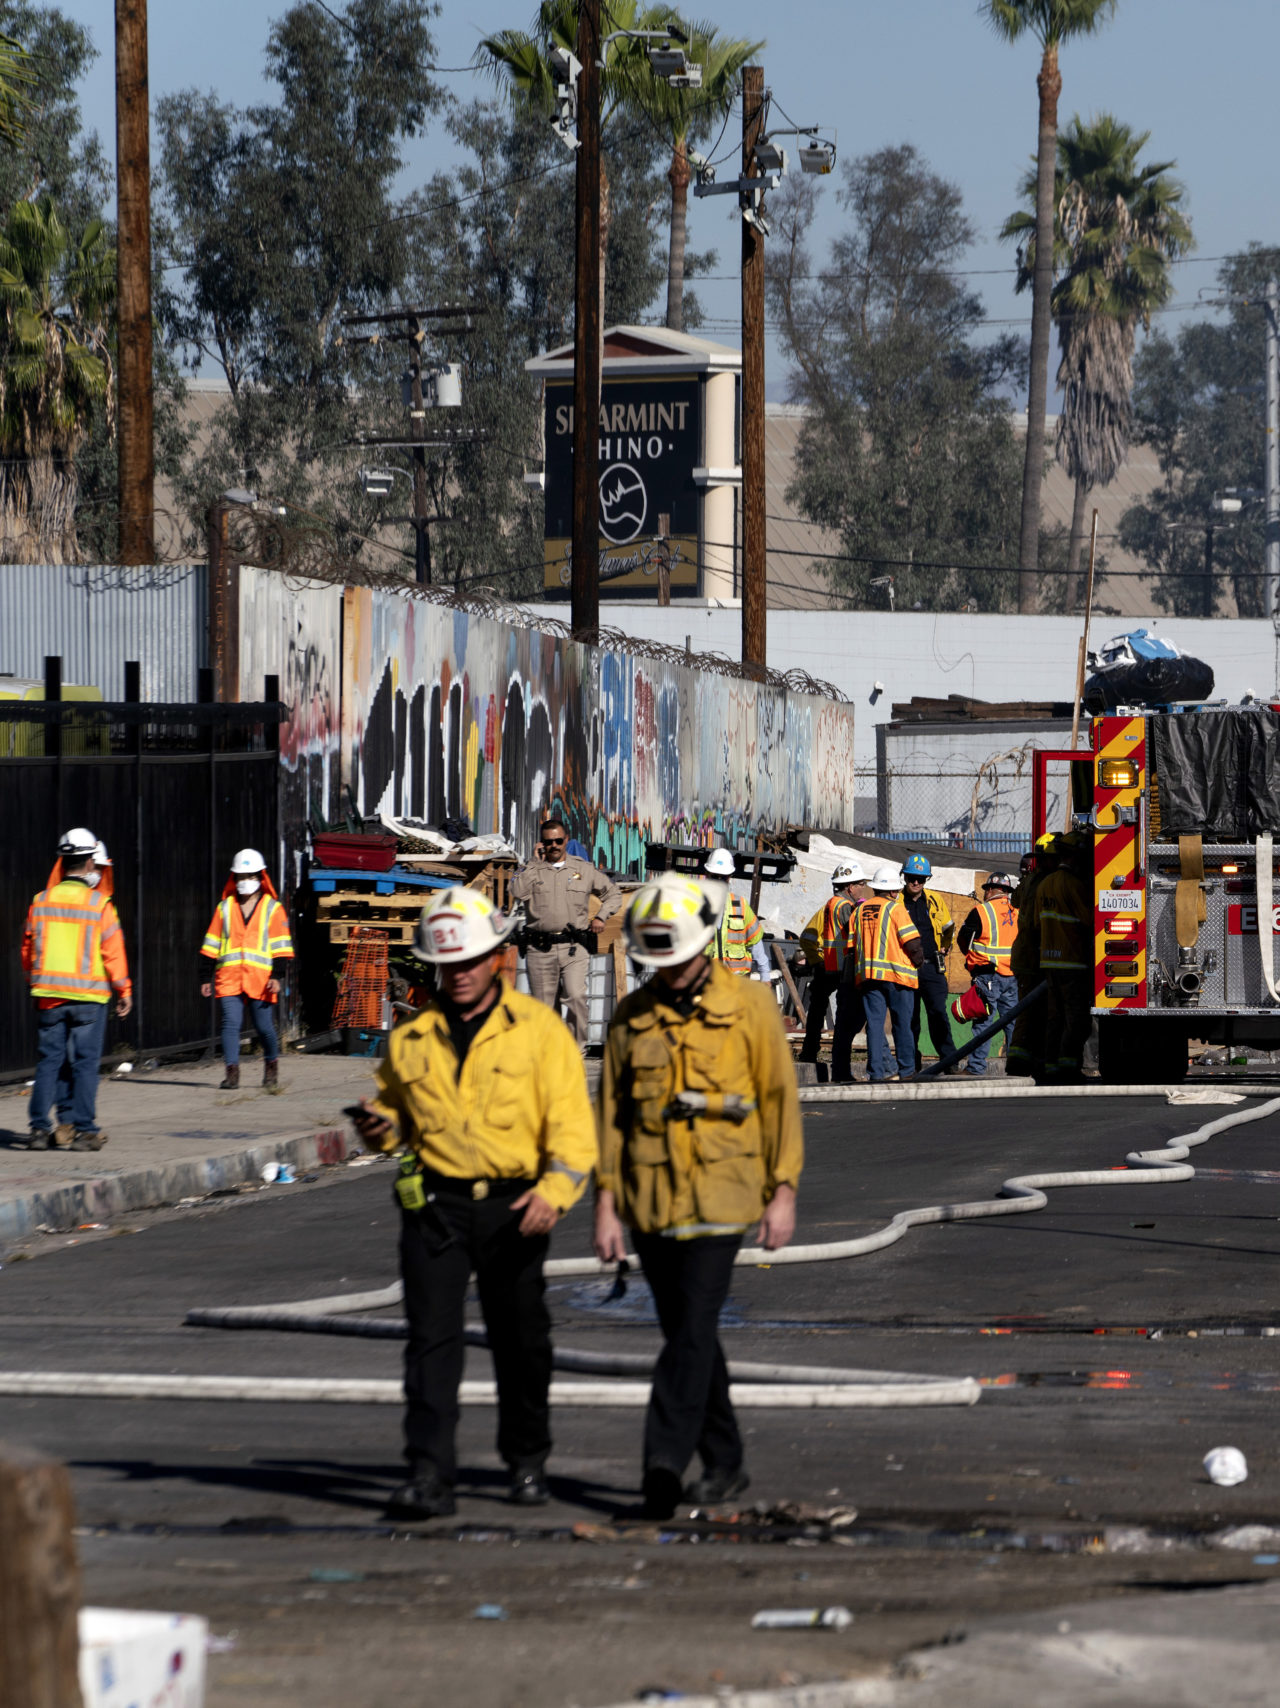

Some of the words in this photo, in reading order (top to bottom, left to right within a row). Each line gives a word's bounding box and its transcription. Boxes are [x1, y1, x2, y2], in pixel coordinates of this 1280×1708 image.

[555, 402, 690, 435] SARMINT
[598, 436, 663, 460] HINO
[1102, 897, 1139, 909] 1407034
